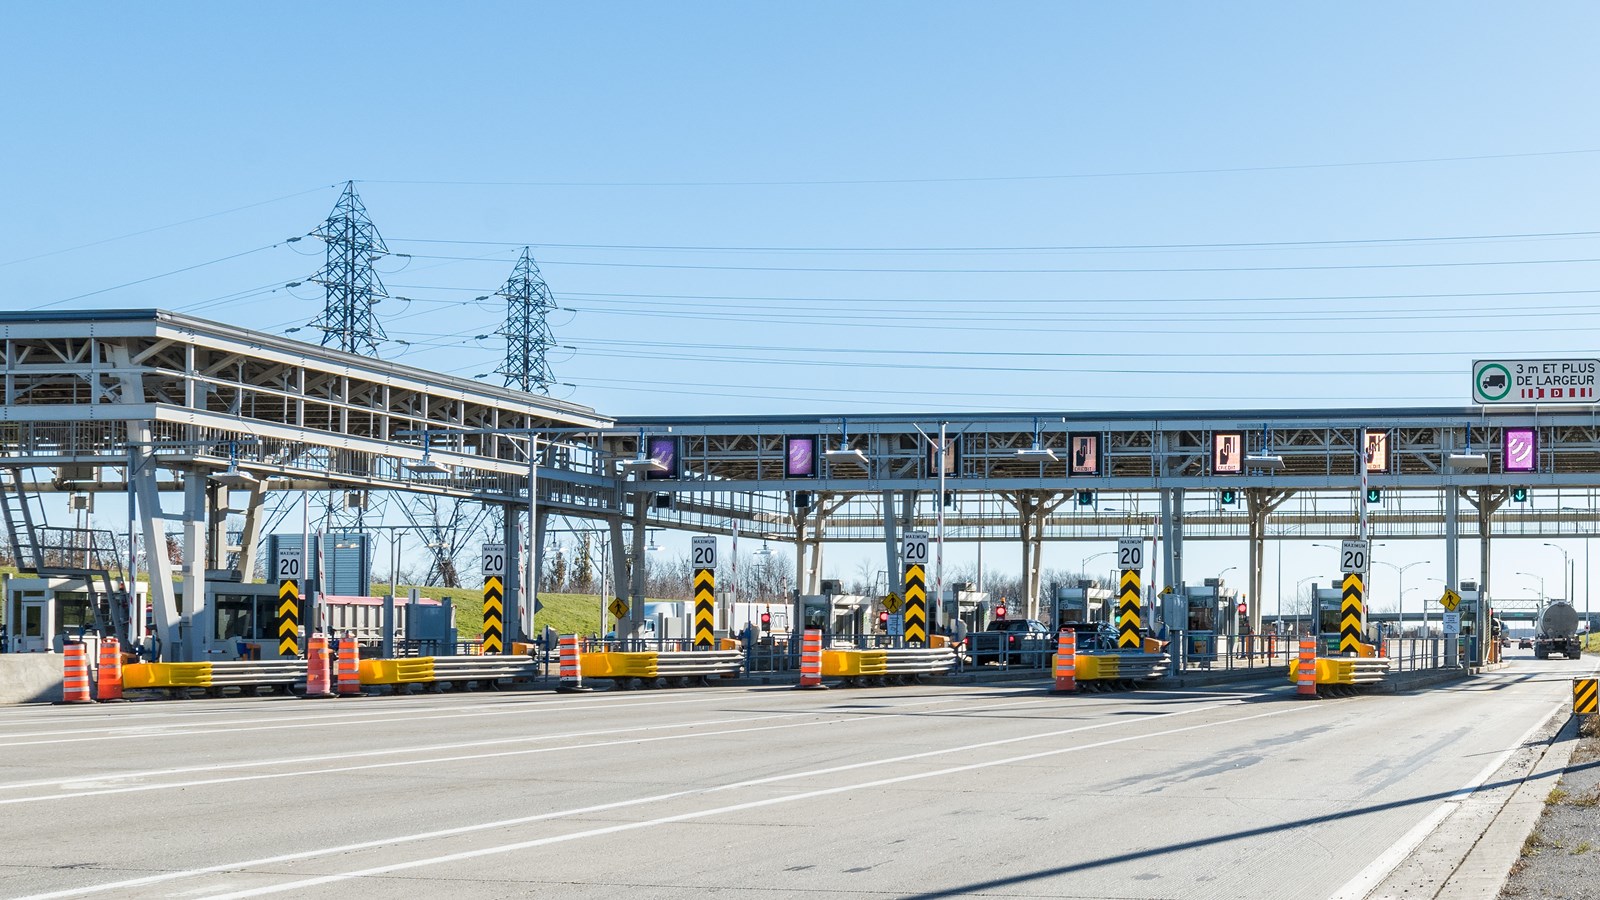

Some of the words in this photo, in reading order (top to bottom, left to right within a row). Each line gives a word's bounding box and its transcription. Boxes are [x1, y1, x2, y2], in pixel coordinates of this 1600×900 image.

[1516, 364, 1524, 374] 3
[1528, 365, 1538, 374] m
[1543, 363, 1558, 374] ET
[1562, 363, 1596, 374] PLUS
[1516, 376, 1533, 386] DE
[1536, 375, 1595, 386] LARGEUR
[1553, 389, 1560, 397] D
[694, 547, 714, 564] 20
[906, 542, 926, 559] 20
[1120, 547, 1141, 564] 20
[280, 559, 299, 575] 20
[484, 555, 504, 571] 20
[1343, 551, 1364, 568] 20
